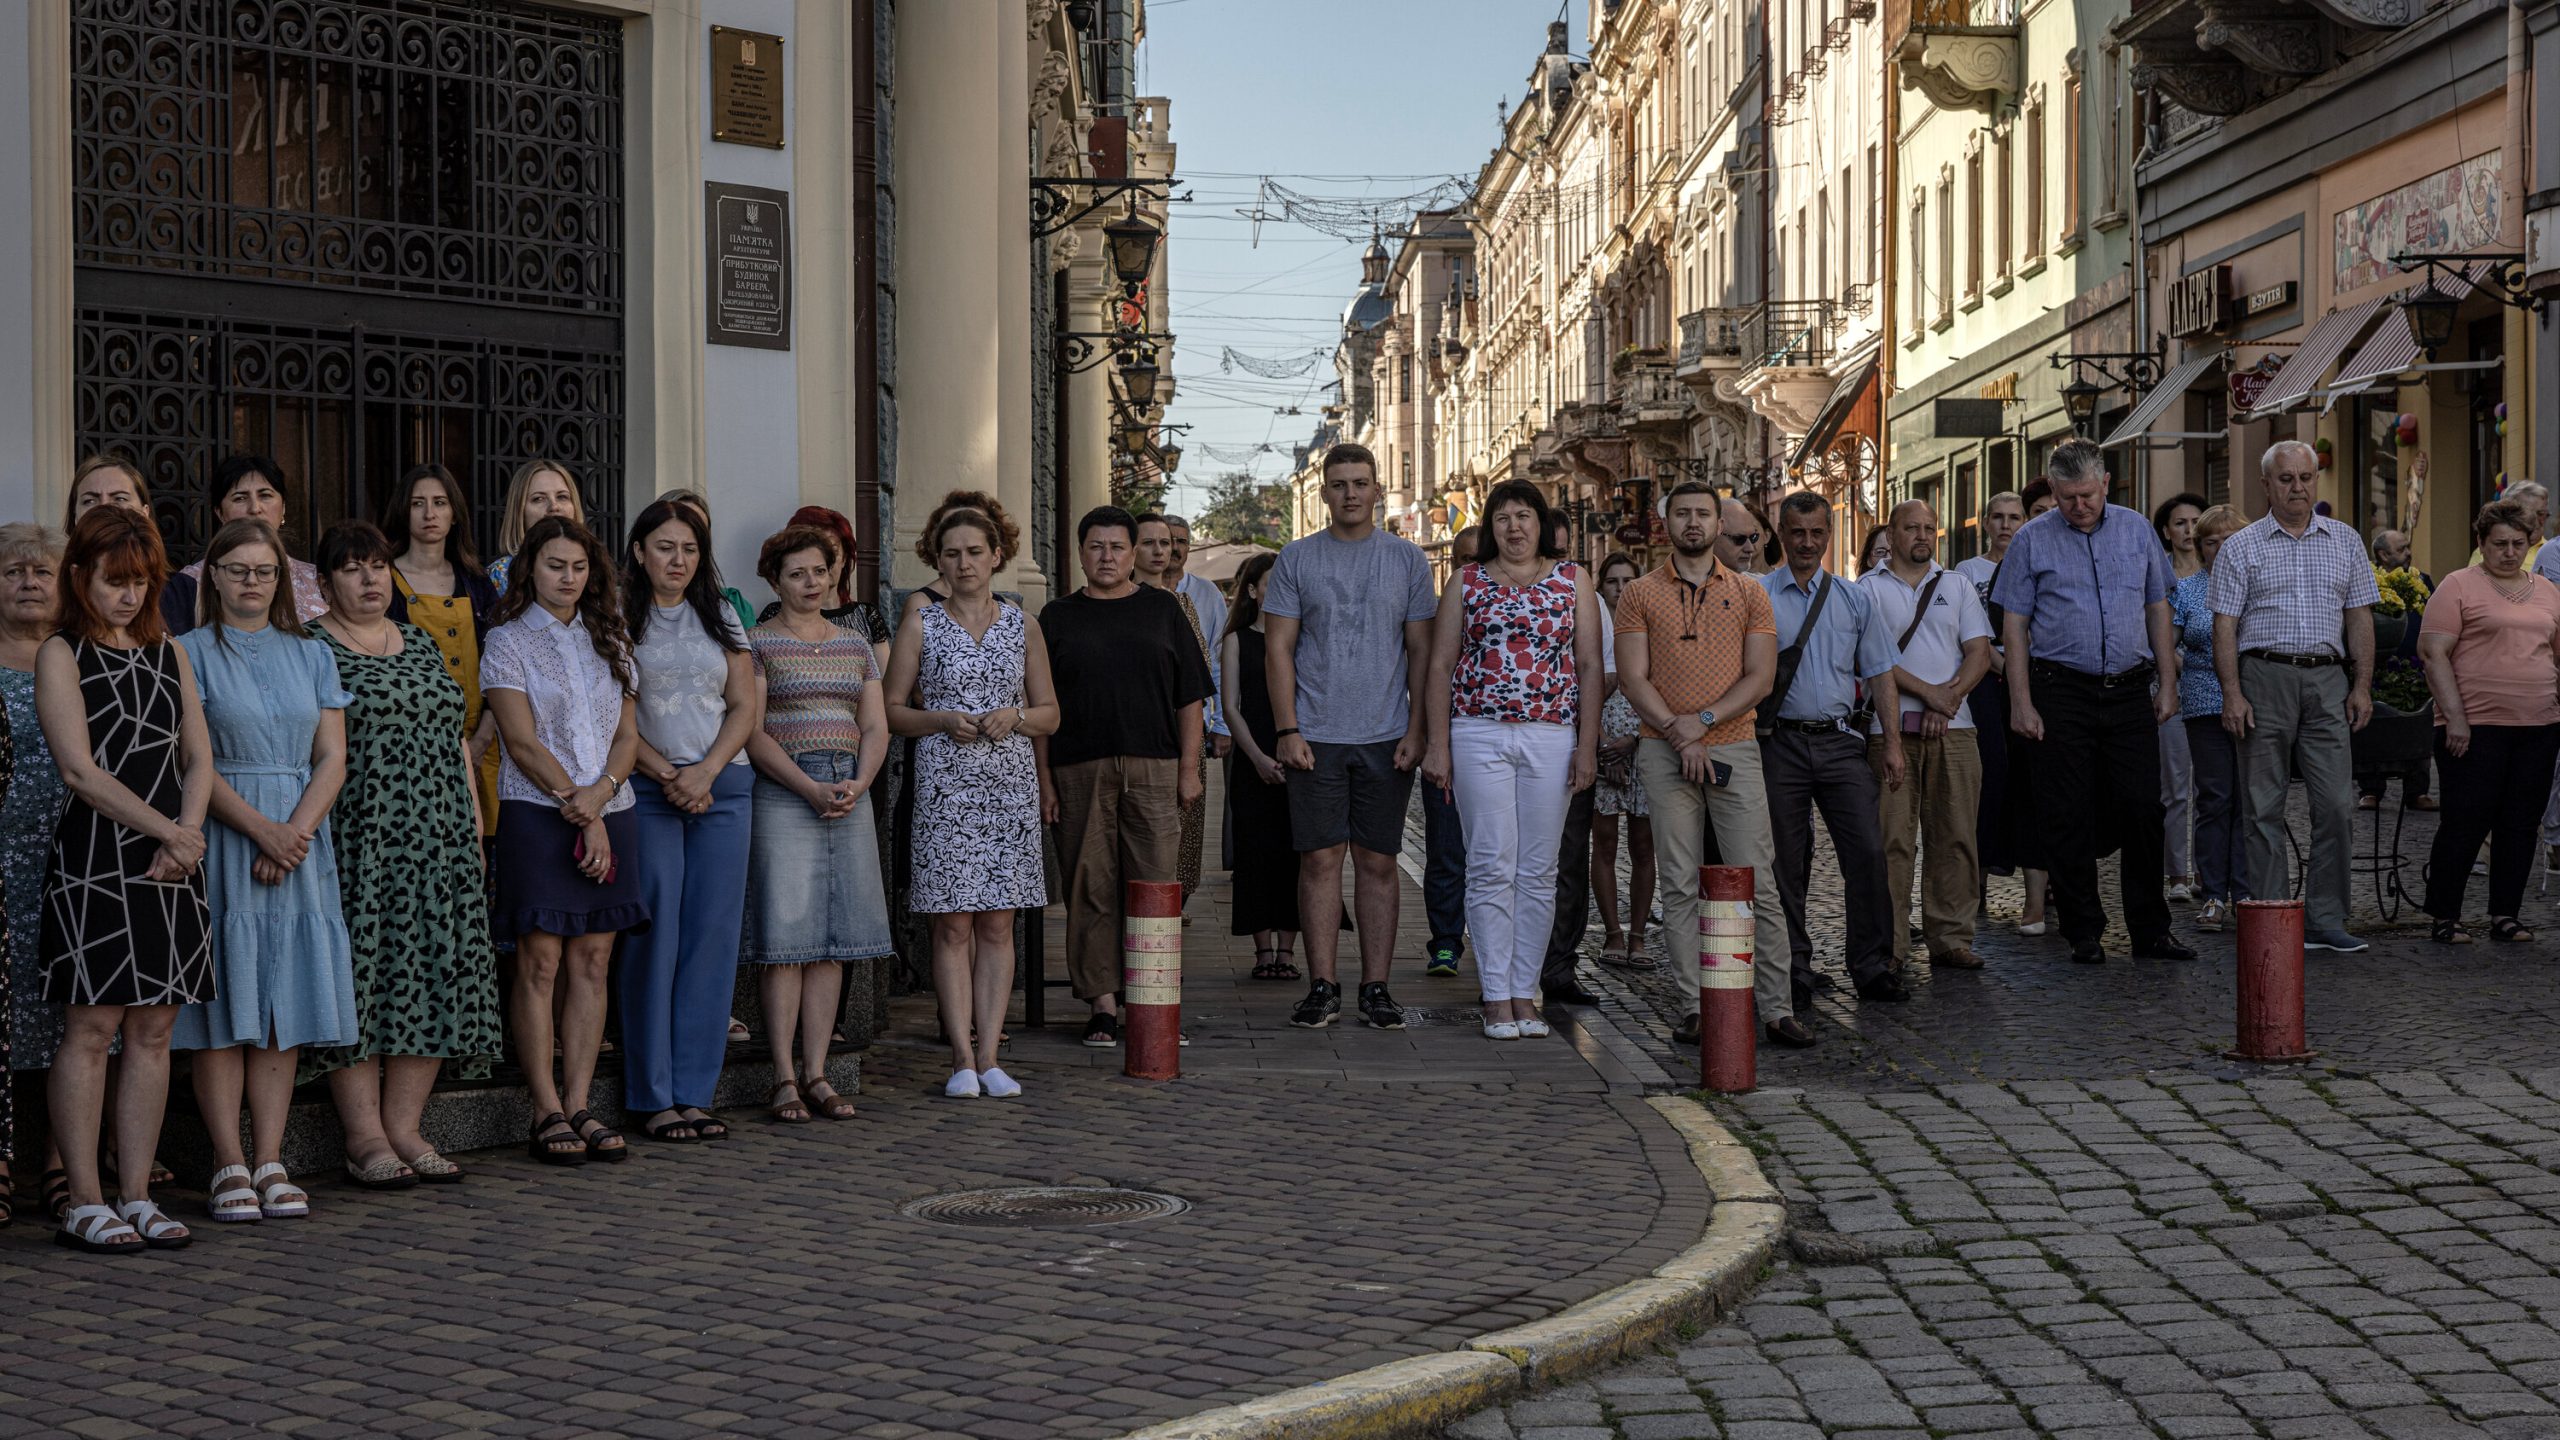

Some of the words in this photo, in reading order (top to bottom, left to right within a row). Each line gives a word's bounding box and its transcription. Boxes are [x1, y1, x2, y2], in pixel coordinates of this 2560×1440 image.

[726, 259, 778, 272] ПРИБУТКОВИЙ
[734, 270, 769, 281] БУДИНОК
[2167, 265, 2219, 339] ГАЛЕРЕЯ
[2251, 286, 2281, 309] ВЗУТТЯ
